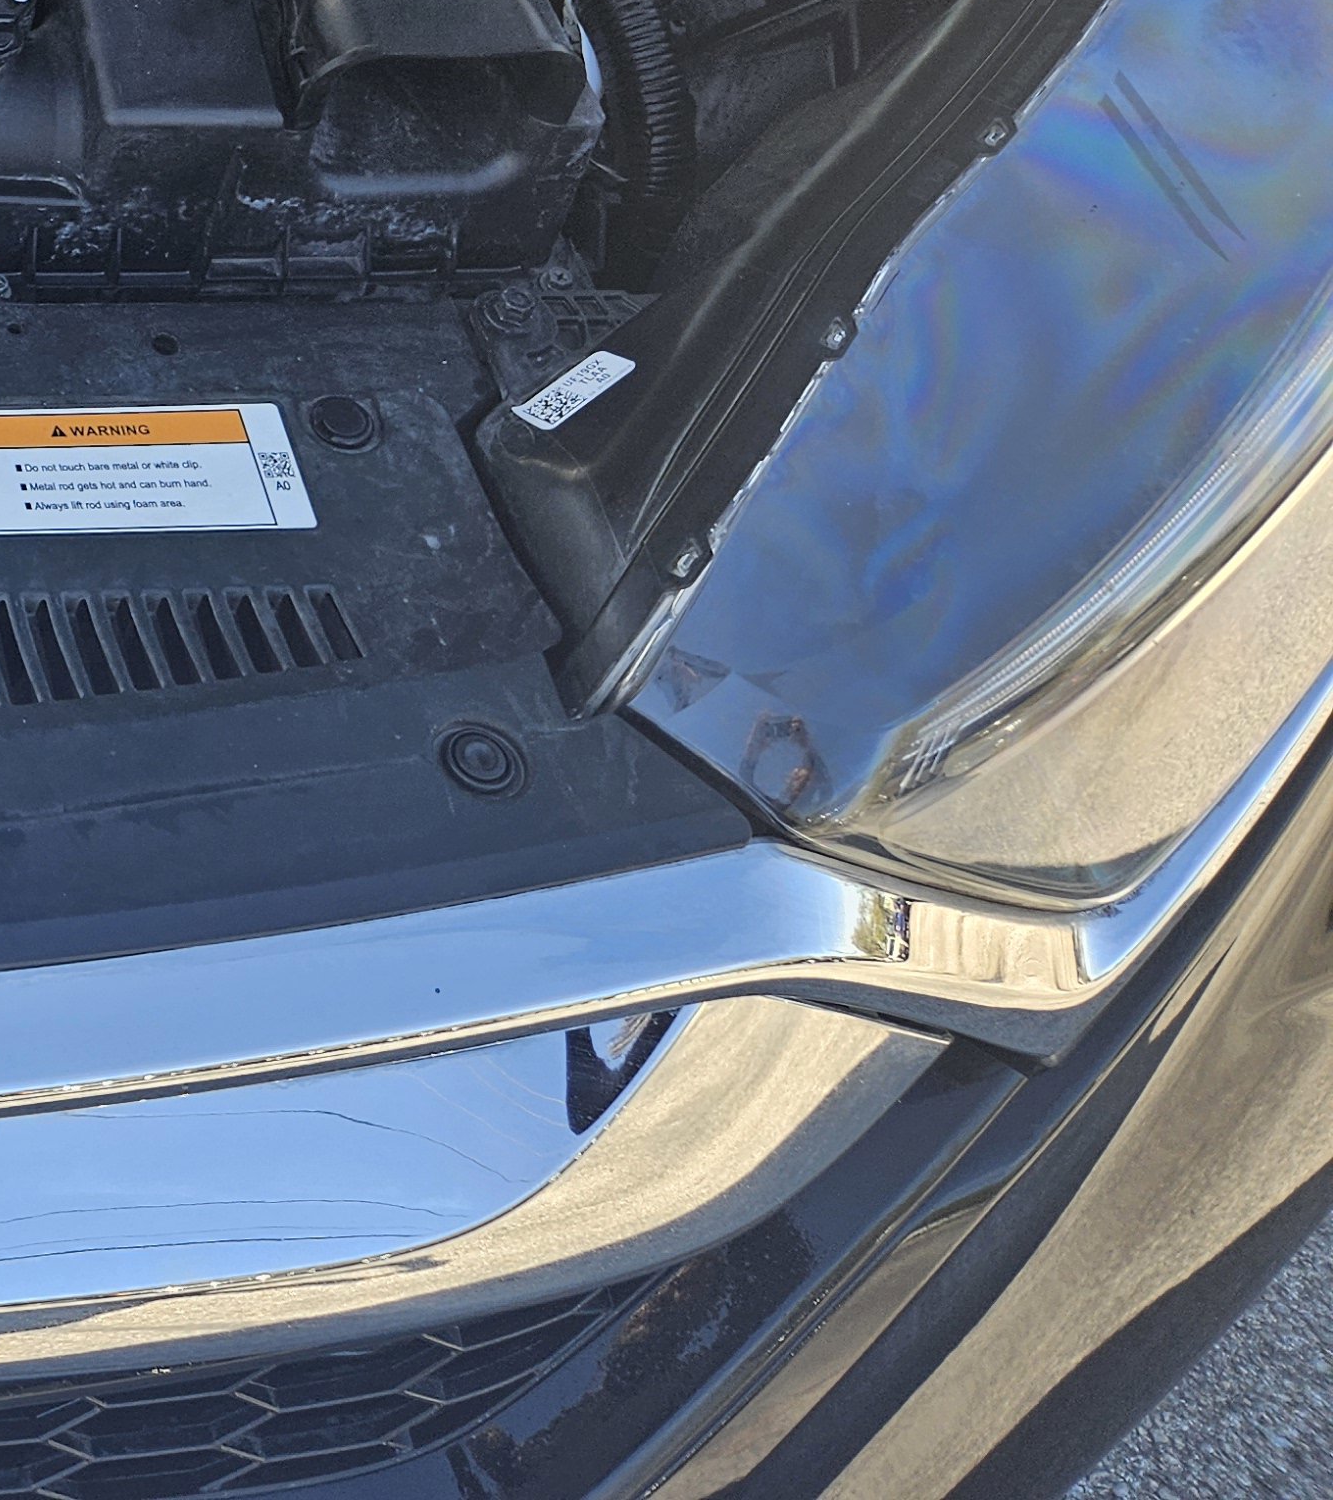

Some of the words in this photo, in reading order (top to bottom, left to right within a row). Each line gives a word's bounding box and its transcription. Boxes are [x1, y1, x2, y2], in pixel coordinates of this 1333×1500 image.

[69, 424, 151, 437] WARNING
[24, 463, 39, 473] Do
[41, 463, 58, 473] not
[58, 463, 86, 472] touch
[87, 462, 110, 471] bare
[112, 461, 139, 471] metal
[141, 462, 151, 470] or
[154, 460, 180, 469] white
[181, 460, 203, 470] clip.
[29, 482, 57, 491] Metal
[58, 482, 74, 491] rod
[76, 482, 99, 492] gets
[100, 481, 117, 490] hot
[118, 480, 137, 489] and
[139, 481, 157, 489] can
[183, 479, 212, 488] hand.
[276, 480, 291, 491] A0
[34, 501, 69, 512] Always
[71, 501, 83, 510] lift
[85, 501, 102, 509] rod
[104, 500, 131, 510] using
[132, 499, 157, 508] foam
[160, 499, 186, 508] area.
